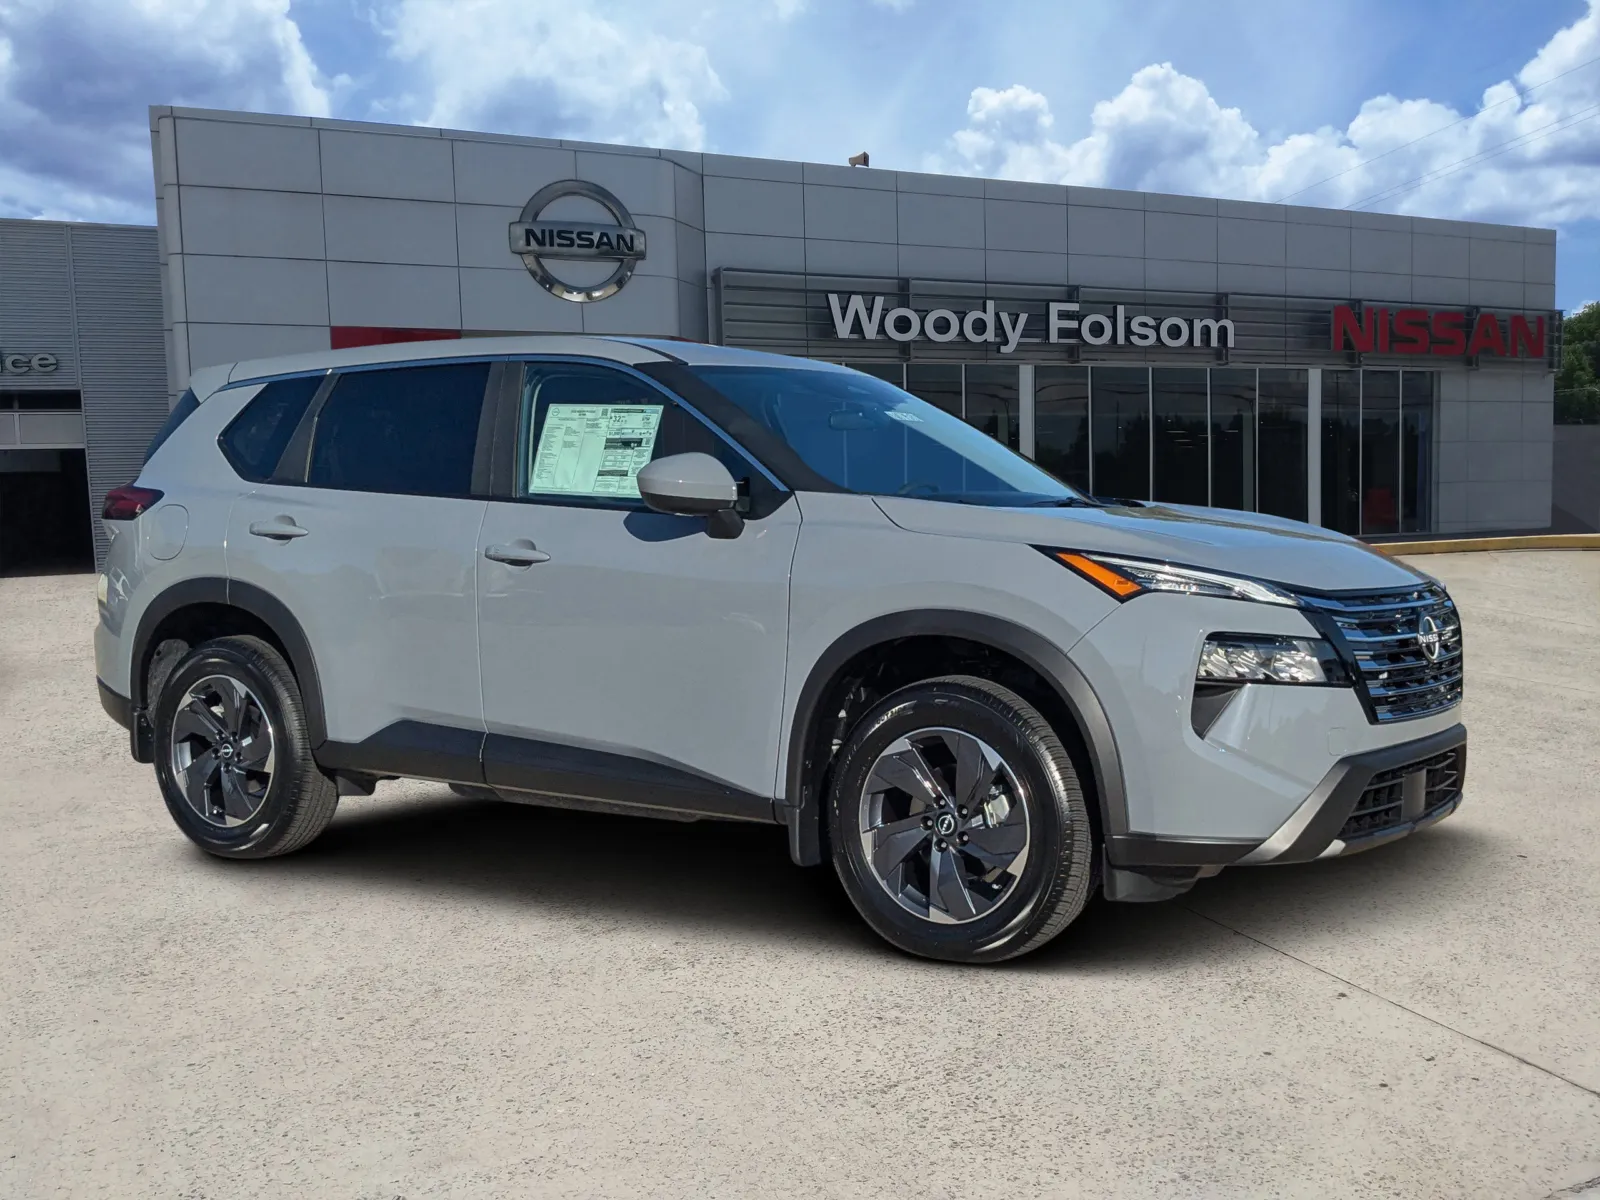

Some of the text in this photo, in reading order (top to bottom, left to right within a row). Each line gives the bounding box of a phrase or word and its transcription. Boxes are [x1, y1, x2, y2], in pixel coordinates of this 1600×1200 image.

[525, 228, 635, 252] NISSAN
[827, 293, 1235, 353] Woody Folsom
[1333, 304, 1545, 358] NISSAN
[0, 353, 57, 373] ce
